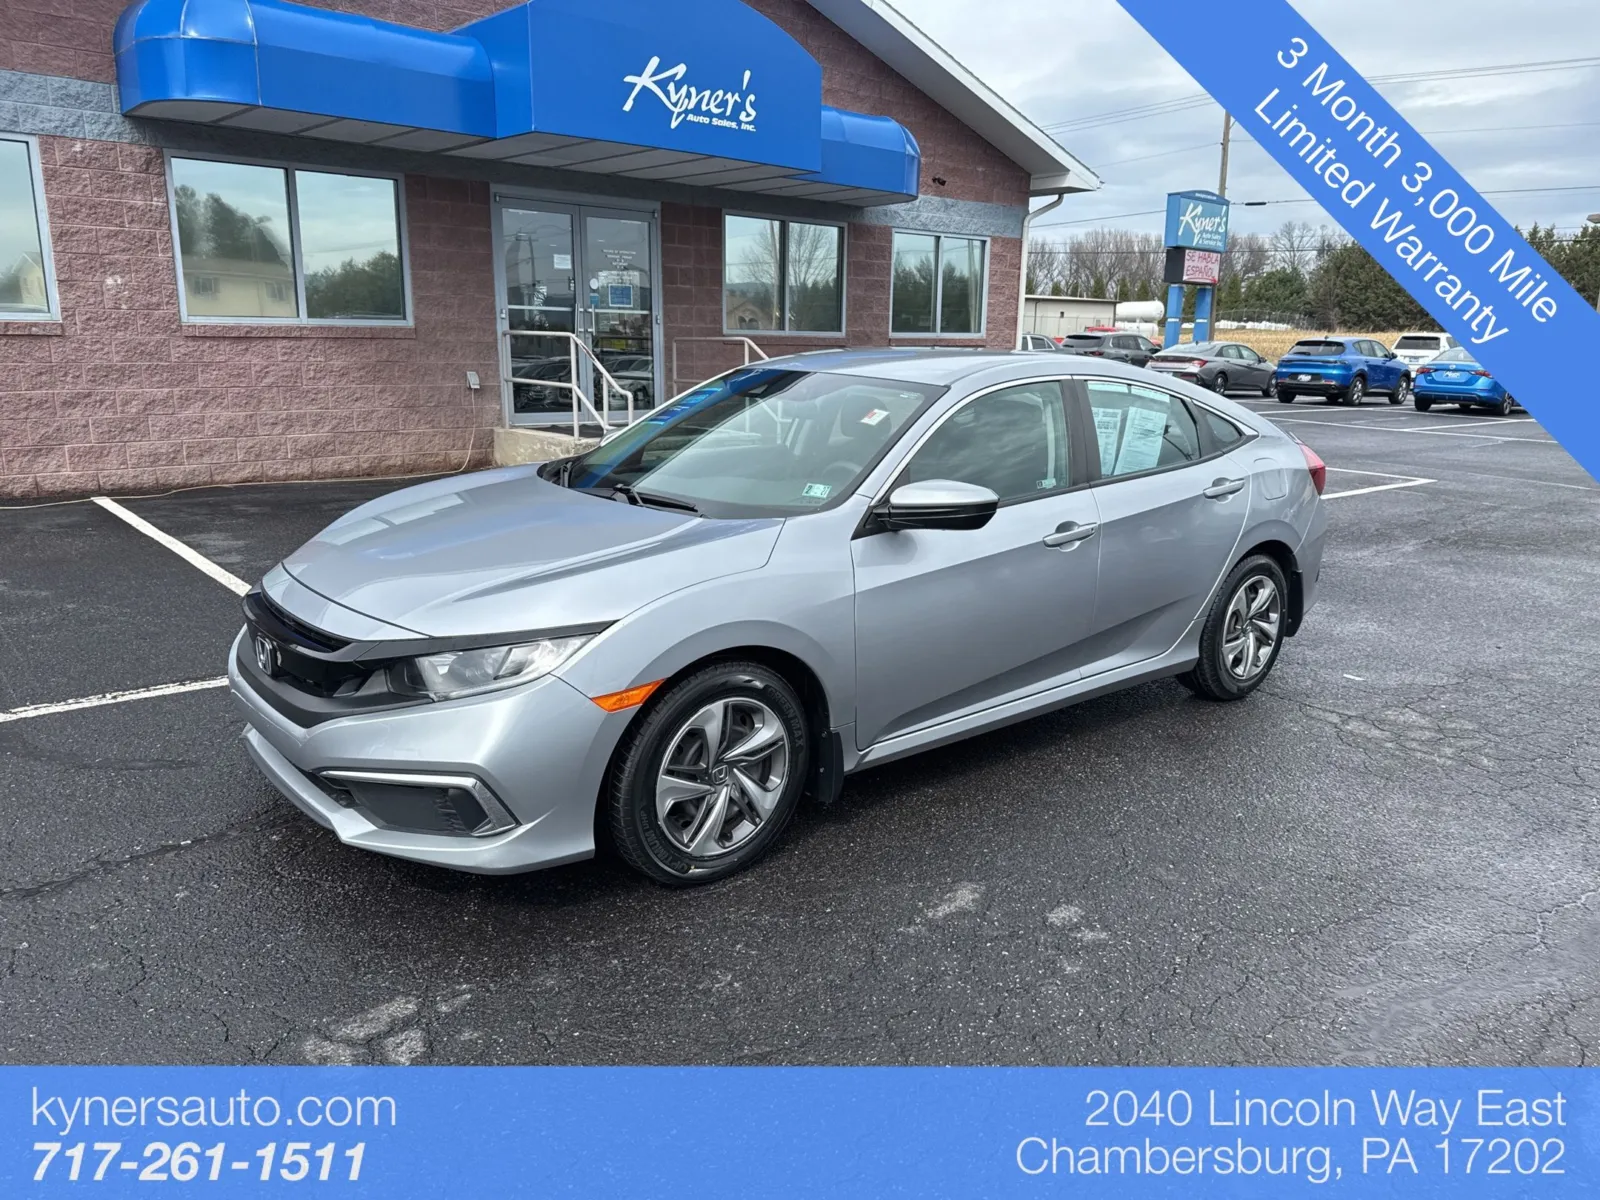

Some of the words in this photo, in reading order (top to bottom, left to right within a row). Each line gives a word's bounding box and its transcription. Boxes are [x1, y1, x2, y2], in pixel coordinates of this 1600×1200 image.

[622, 55, 757, 130] Kyner's
[686, 113, 710, 125] Auto
[711, 117, 739, 130] Sales,
[740, 121, 757, 132] Inc.
[1178, 202, 1227, 247] Kyner's
[1186, 251, 1197, 262] SE
[1197, 252, 1219, 264] HABLA
[1186, 265, 1216, 278] ESPAÑOL
[645, 829, 688, 872] OPTIMUM
